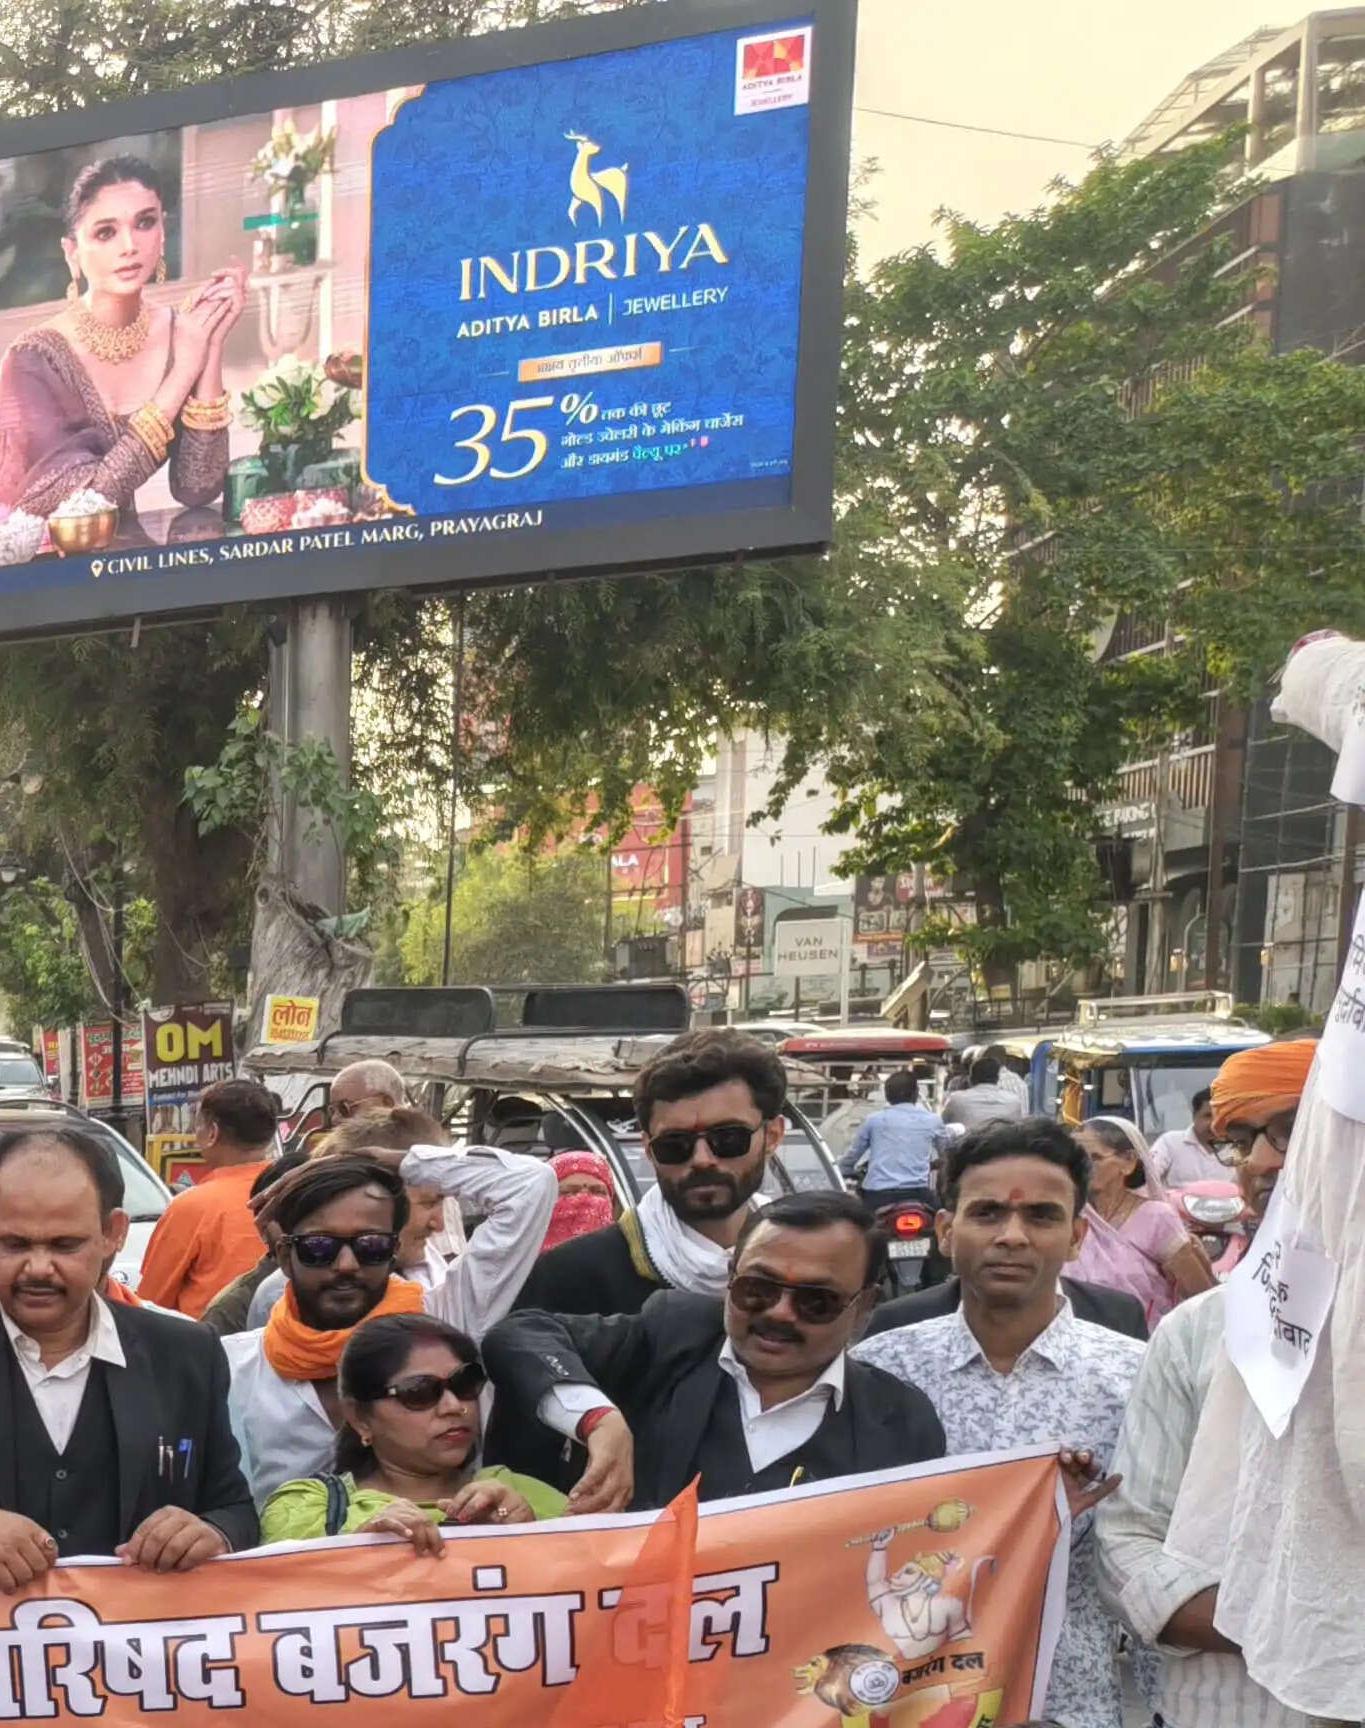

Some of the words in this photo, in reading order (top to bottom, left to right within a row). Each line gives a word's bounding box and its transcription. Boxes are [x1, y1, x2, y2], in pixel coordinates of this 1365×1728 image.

[459, 223, 729, 301] INDRIYA
[456, 314, 530, 339] ADITYA
[538, 304, 598, 328] BIRLA
[623, 286, 729, 316] JEWELLERY
[107, 557, 153, 575] CIVIL
[159, 548, 214, 570] LINES,
[219, 539, 294, 562] SARDAR
[299, 531, 355, 553] PATEL
[361, 523, 424, 544] MARG,
[429, 509, 544, 538] PRAYAGRAJ
[778, 949, 838, 961] HEUSEN
[795, 936, 823, 948] VAN
[272, 999, 313, 1028] लोन
[156, 1018, 224, 1063] OM
[148, 1064, 199, 1089] MEHNDI
[203, 1061, 234, 1083] ARTS
[258, 1565, 581, 1704] बजरंग
[902, 1656, 946, 1684] बजरंग
[950, 1652, 984, 1669] दल
